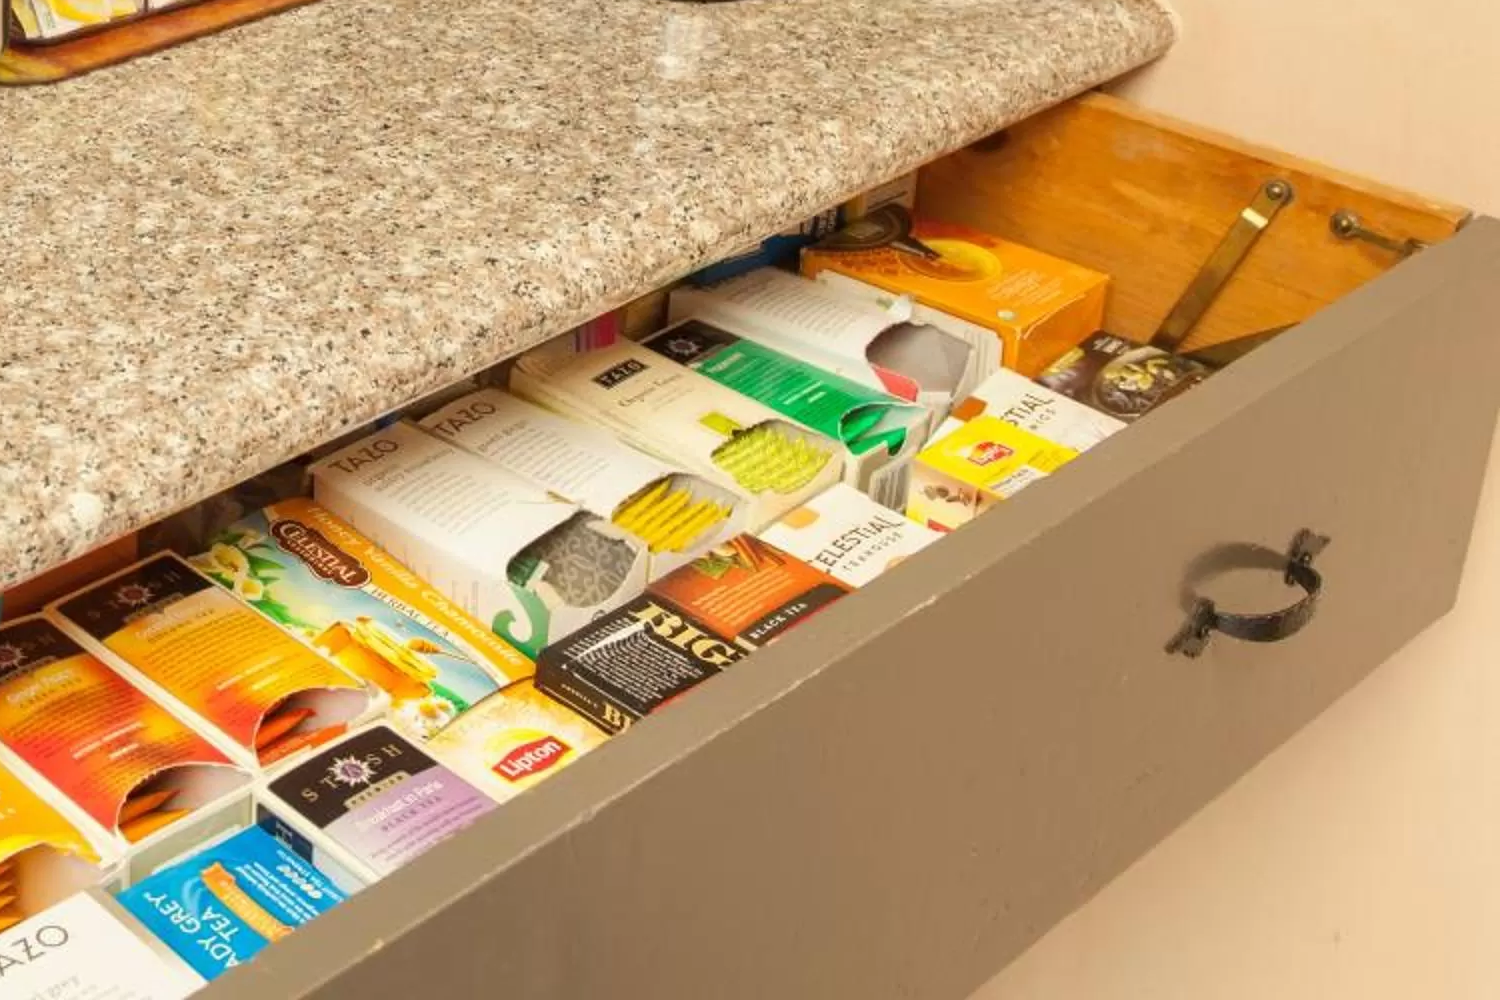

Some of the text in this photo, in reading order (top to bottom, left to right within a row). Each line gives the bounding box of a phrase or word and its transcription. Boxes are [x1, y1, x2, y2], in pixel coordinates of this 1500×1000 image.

[433, 402, 497, 437] TAZO
[1001, 392, 1057, 429] STIAL
[328, 439, 400, 473] TAZO
[279, 521, 358, 583] CELESTIAL
[307, 507, 363, 546] Honey
[364, 546, 420, 590] Vanilla
[421, 589, 524, 666] Chamomile
[749, 615, 786, 640] BLACK
[500, 739, 563, 778] Lipton
[202, 905, 240, 942] TEA
[196, 935, 241, 968] ADY
